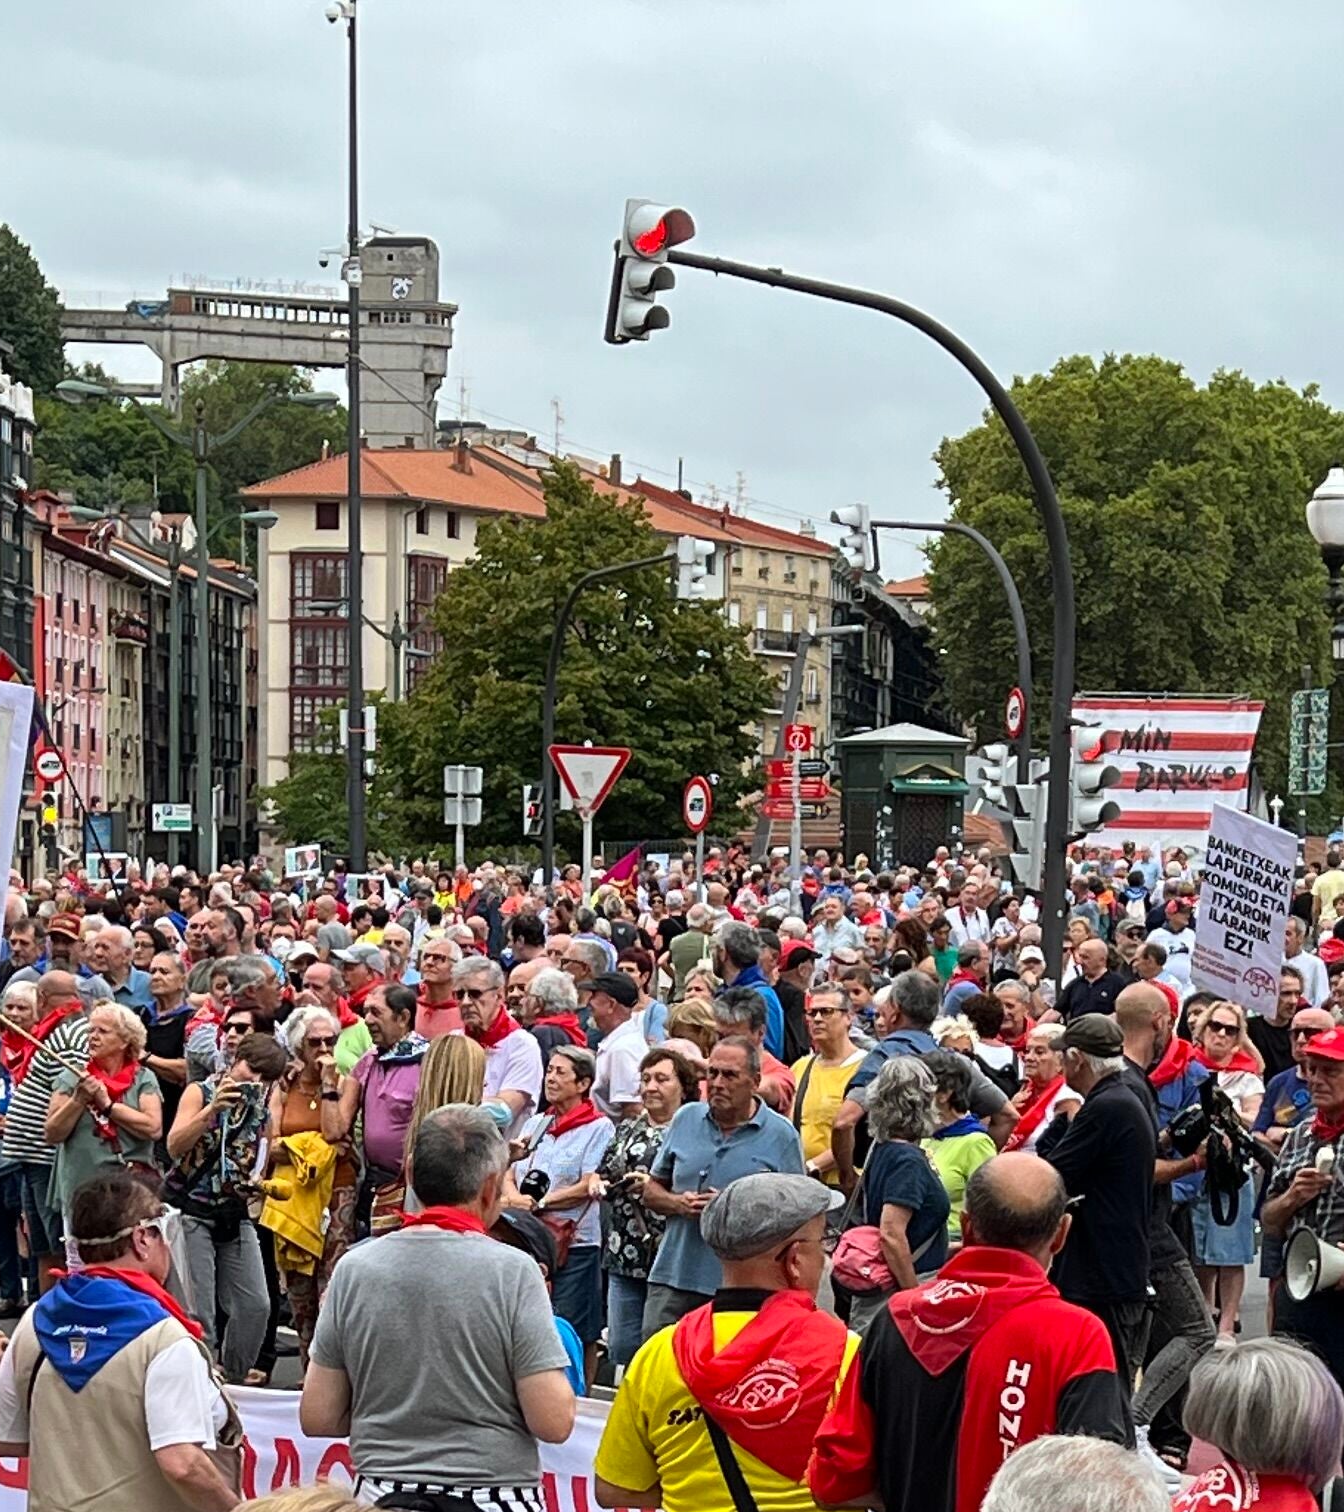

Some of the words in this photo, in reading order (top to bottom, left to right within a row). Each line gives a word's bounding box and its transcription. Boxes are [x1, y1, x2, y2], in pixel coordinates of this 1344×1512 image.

[1206, 849, 1289, 897] LAPURRAK!
[1208, 835, 1291, 881] BANKETXEAK
[1205, 871, 1260, 903] KOMISIO
[1260, 891, 1286, 916] ETA
[1212, 891, 1272, 927] ITXARON
[1209, 906, 1271, 945] ILARARIK
[1224, 930, 1255, 959] EZ!
